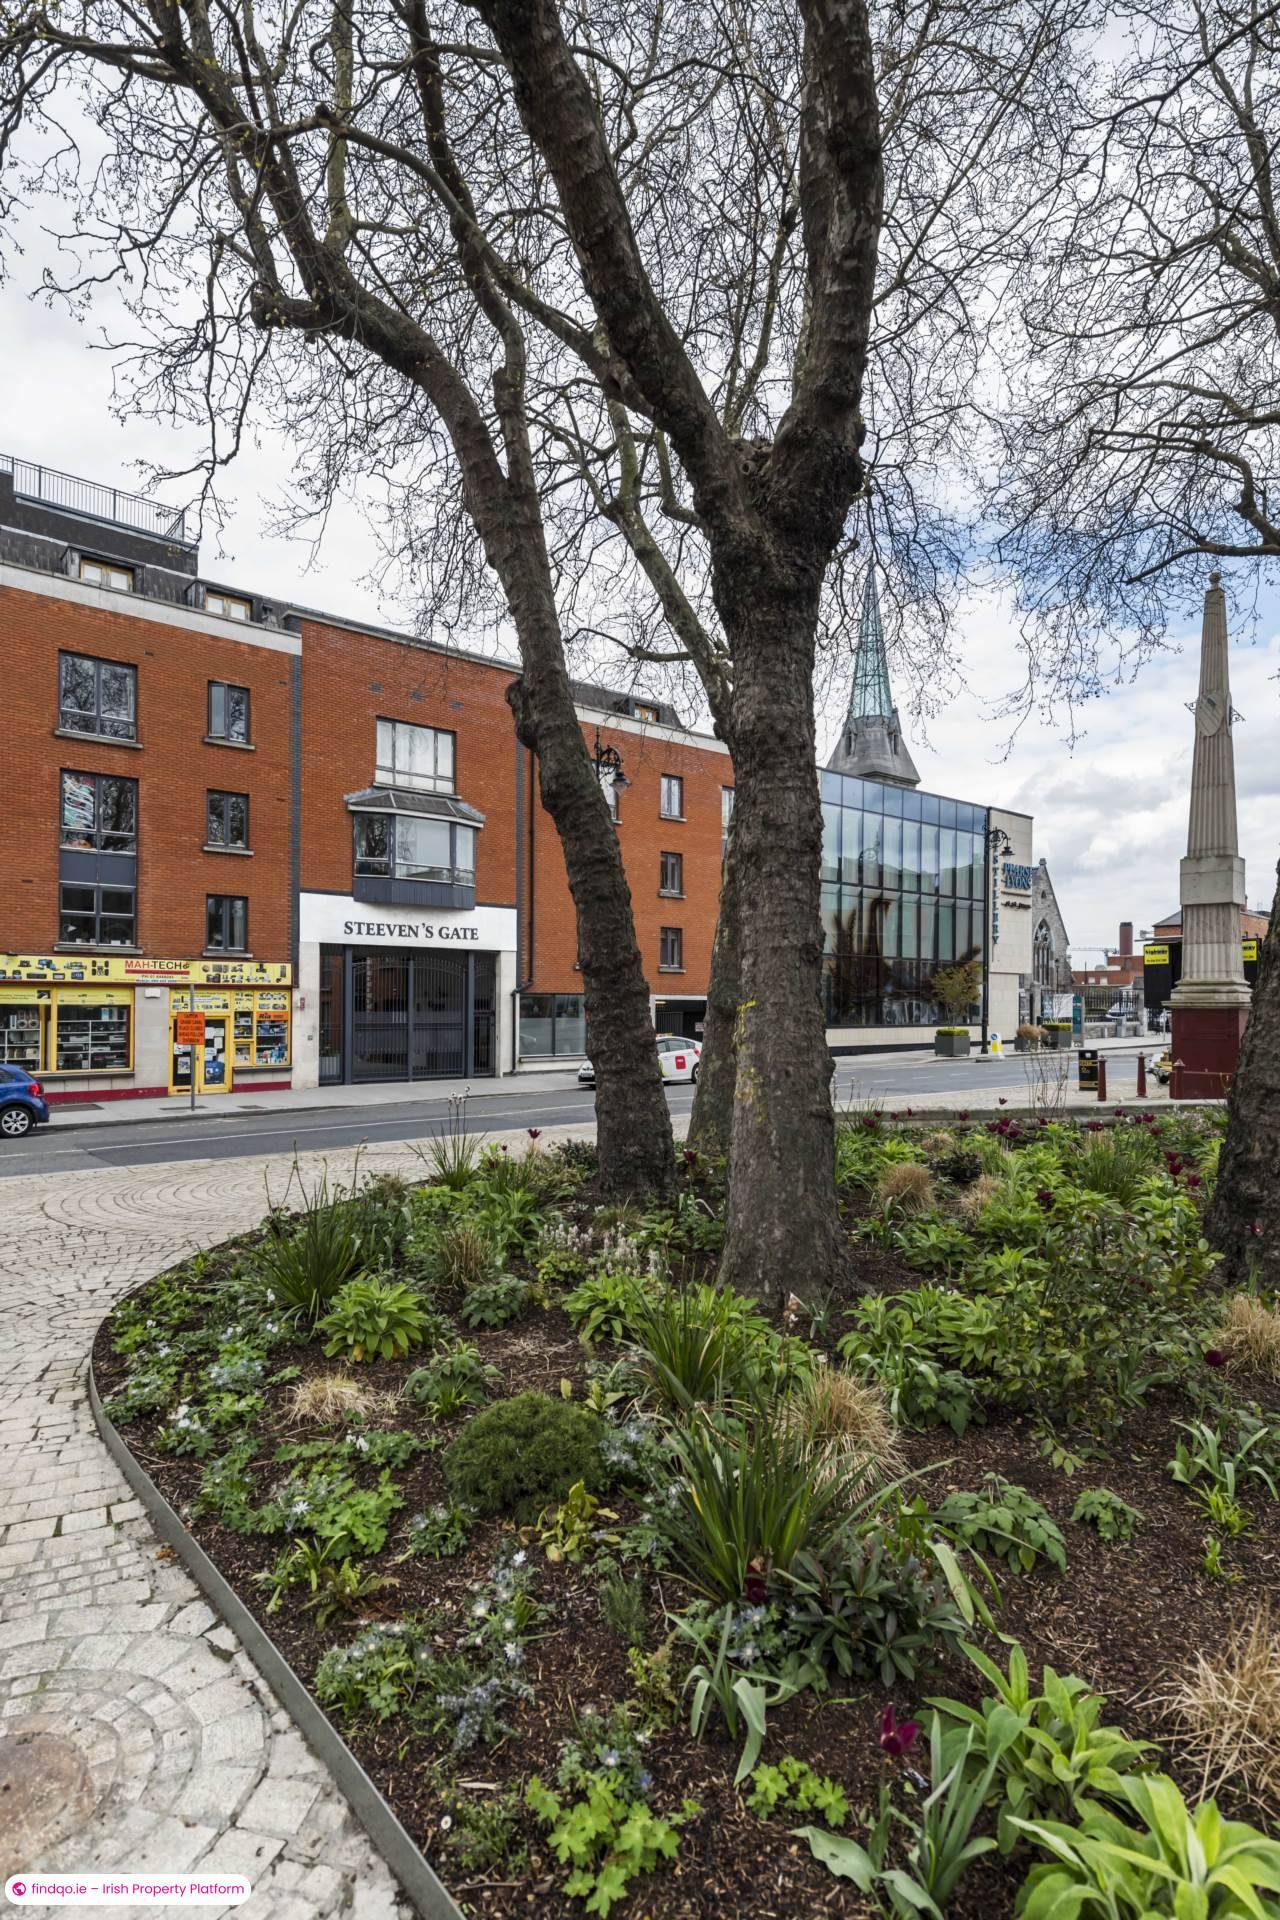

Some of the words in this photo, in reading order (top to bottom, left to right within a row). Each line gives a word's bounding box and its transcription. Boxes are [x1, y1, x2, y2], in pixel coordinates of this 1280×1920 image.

[344, 921, 433, 939] STEEVEN'S
[438, 926, 479, 941] GATE
[125, 960, 182, 970] MAH-TECH
